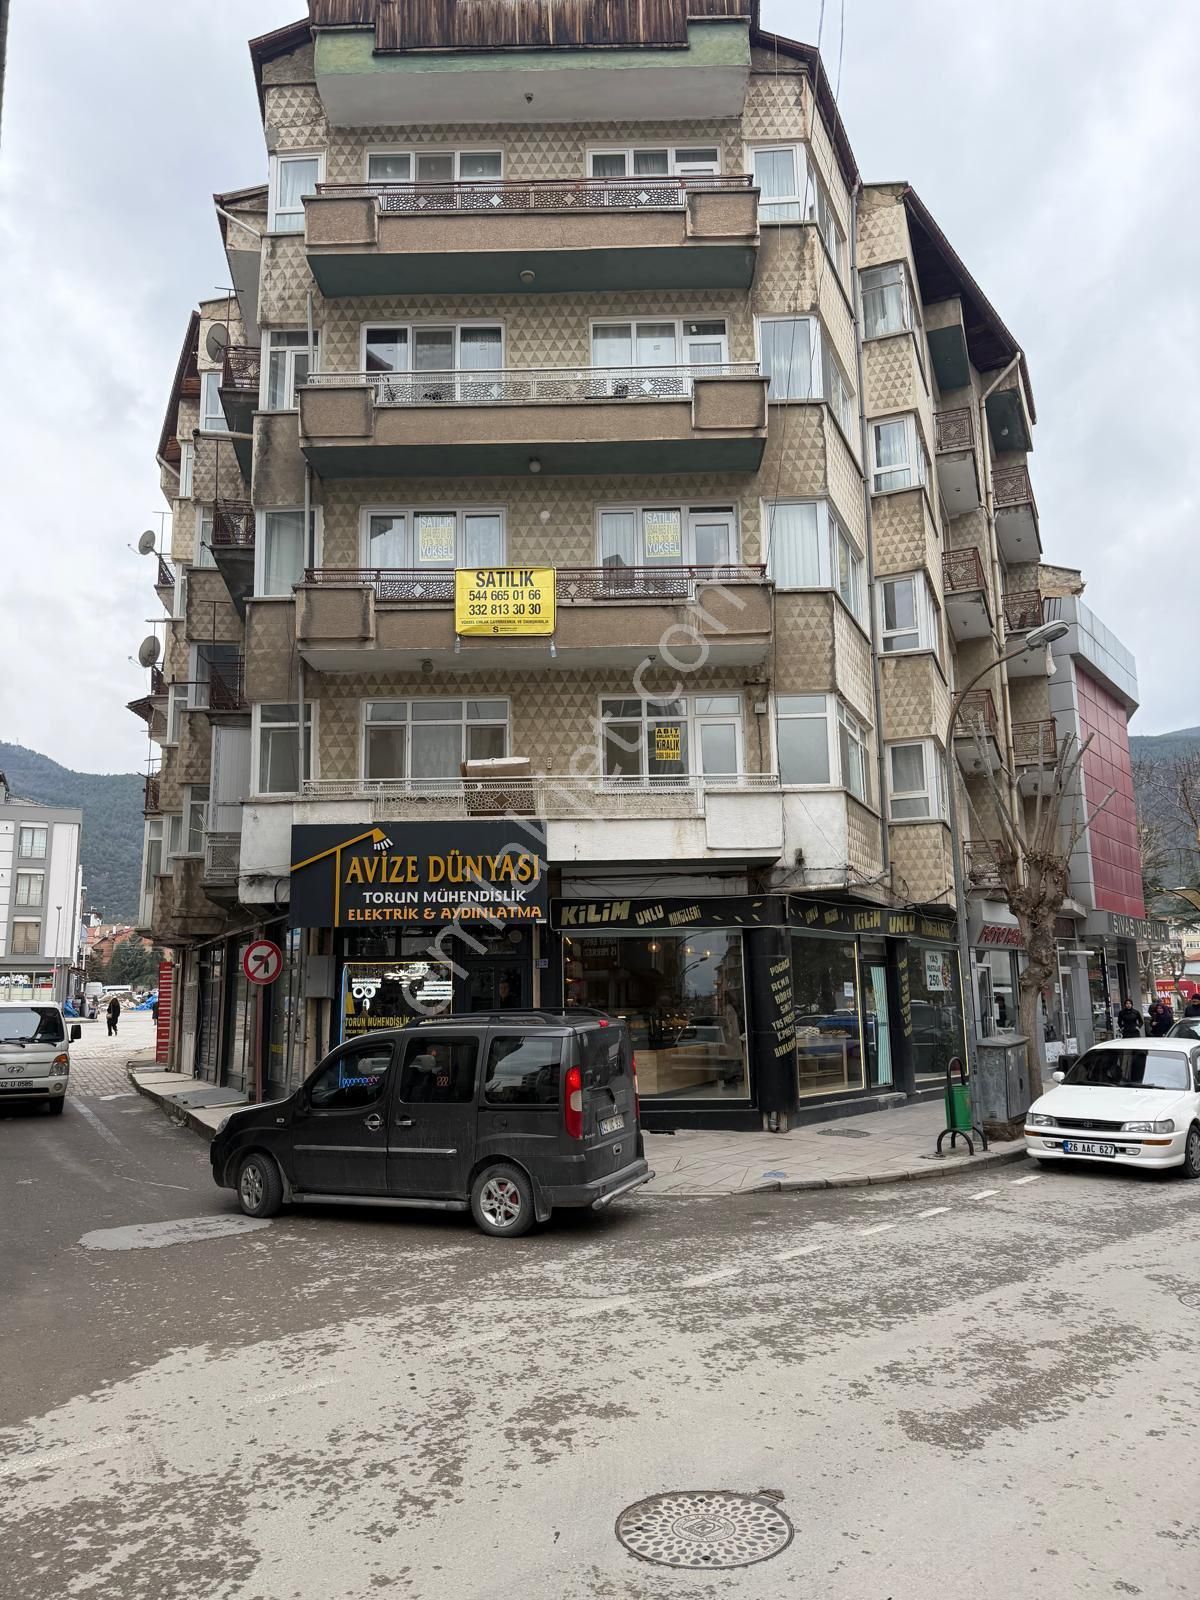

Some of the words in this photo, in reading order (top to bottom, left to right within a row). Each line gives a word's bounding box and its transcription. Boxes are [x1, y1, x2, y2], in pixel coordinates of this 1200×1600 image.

[475, 570, 534, 588] SATILIK
[468, 590, 488, 601] 544
[490, 590, 510, 601] 665
[512, 589, 524, 600] 01
[528, 589, 541, 600] 66
[468, 604, 488, 615] 332
[490, 603, 510, 615] 813
[512, 603, 525, 615] 30
[528, 603, 541, 615] 30
[345, 850, 419, 884] AVİZE
[427, 849, 540, 884] DÜNYASI
[363, 891, 418, 904] TORUN
[423, 887, 526, 903] MÜHENDİSLİK
[347, 907, 418, 921] ELEKTRİK
[423, 907, 437, 920] &
[440, 906, 542, 920] AYDINLATMA
[634, 904, 664, 926] UNLU
[889, 914, 916, 934] UNLU
[344, 1016, 366, 1027] TORUN
[367, 1014, 411, 1027] MÜHENDİSLİK
[1069, 1142, 1078, 1151] 26
[1082, 1143, 1095, 1153] AAC
[1100, 1144, 1113, 1154] 627
